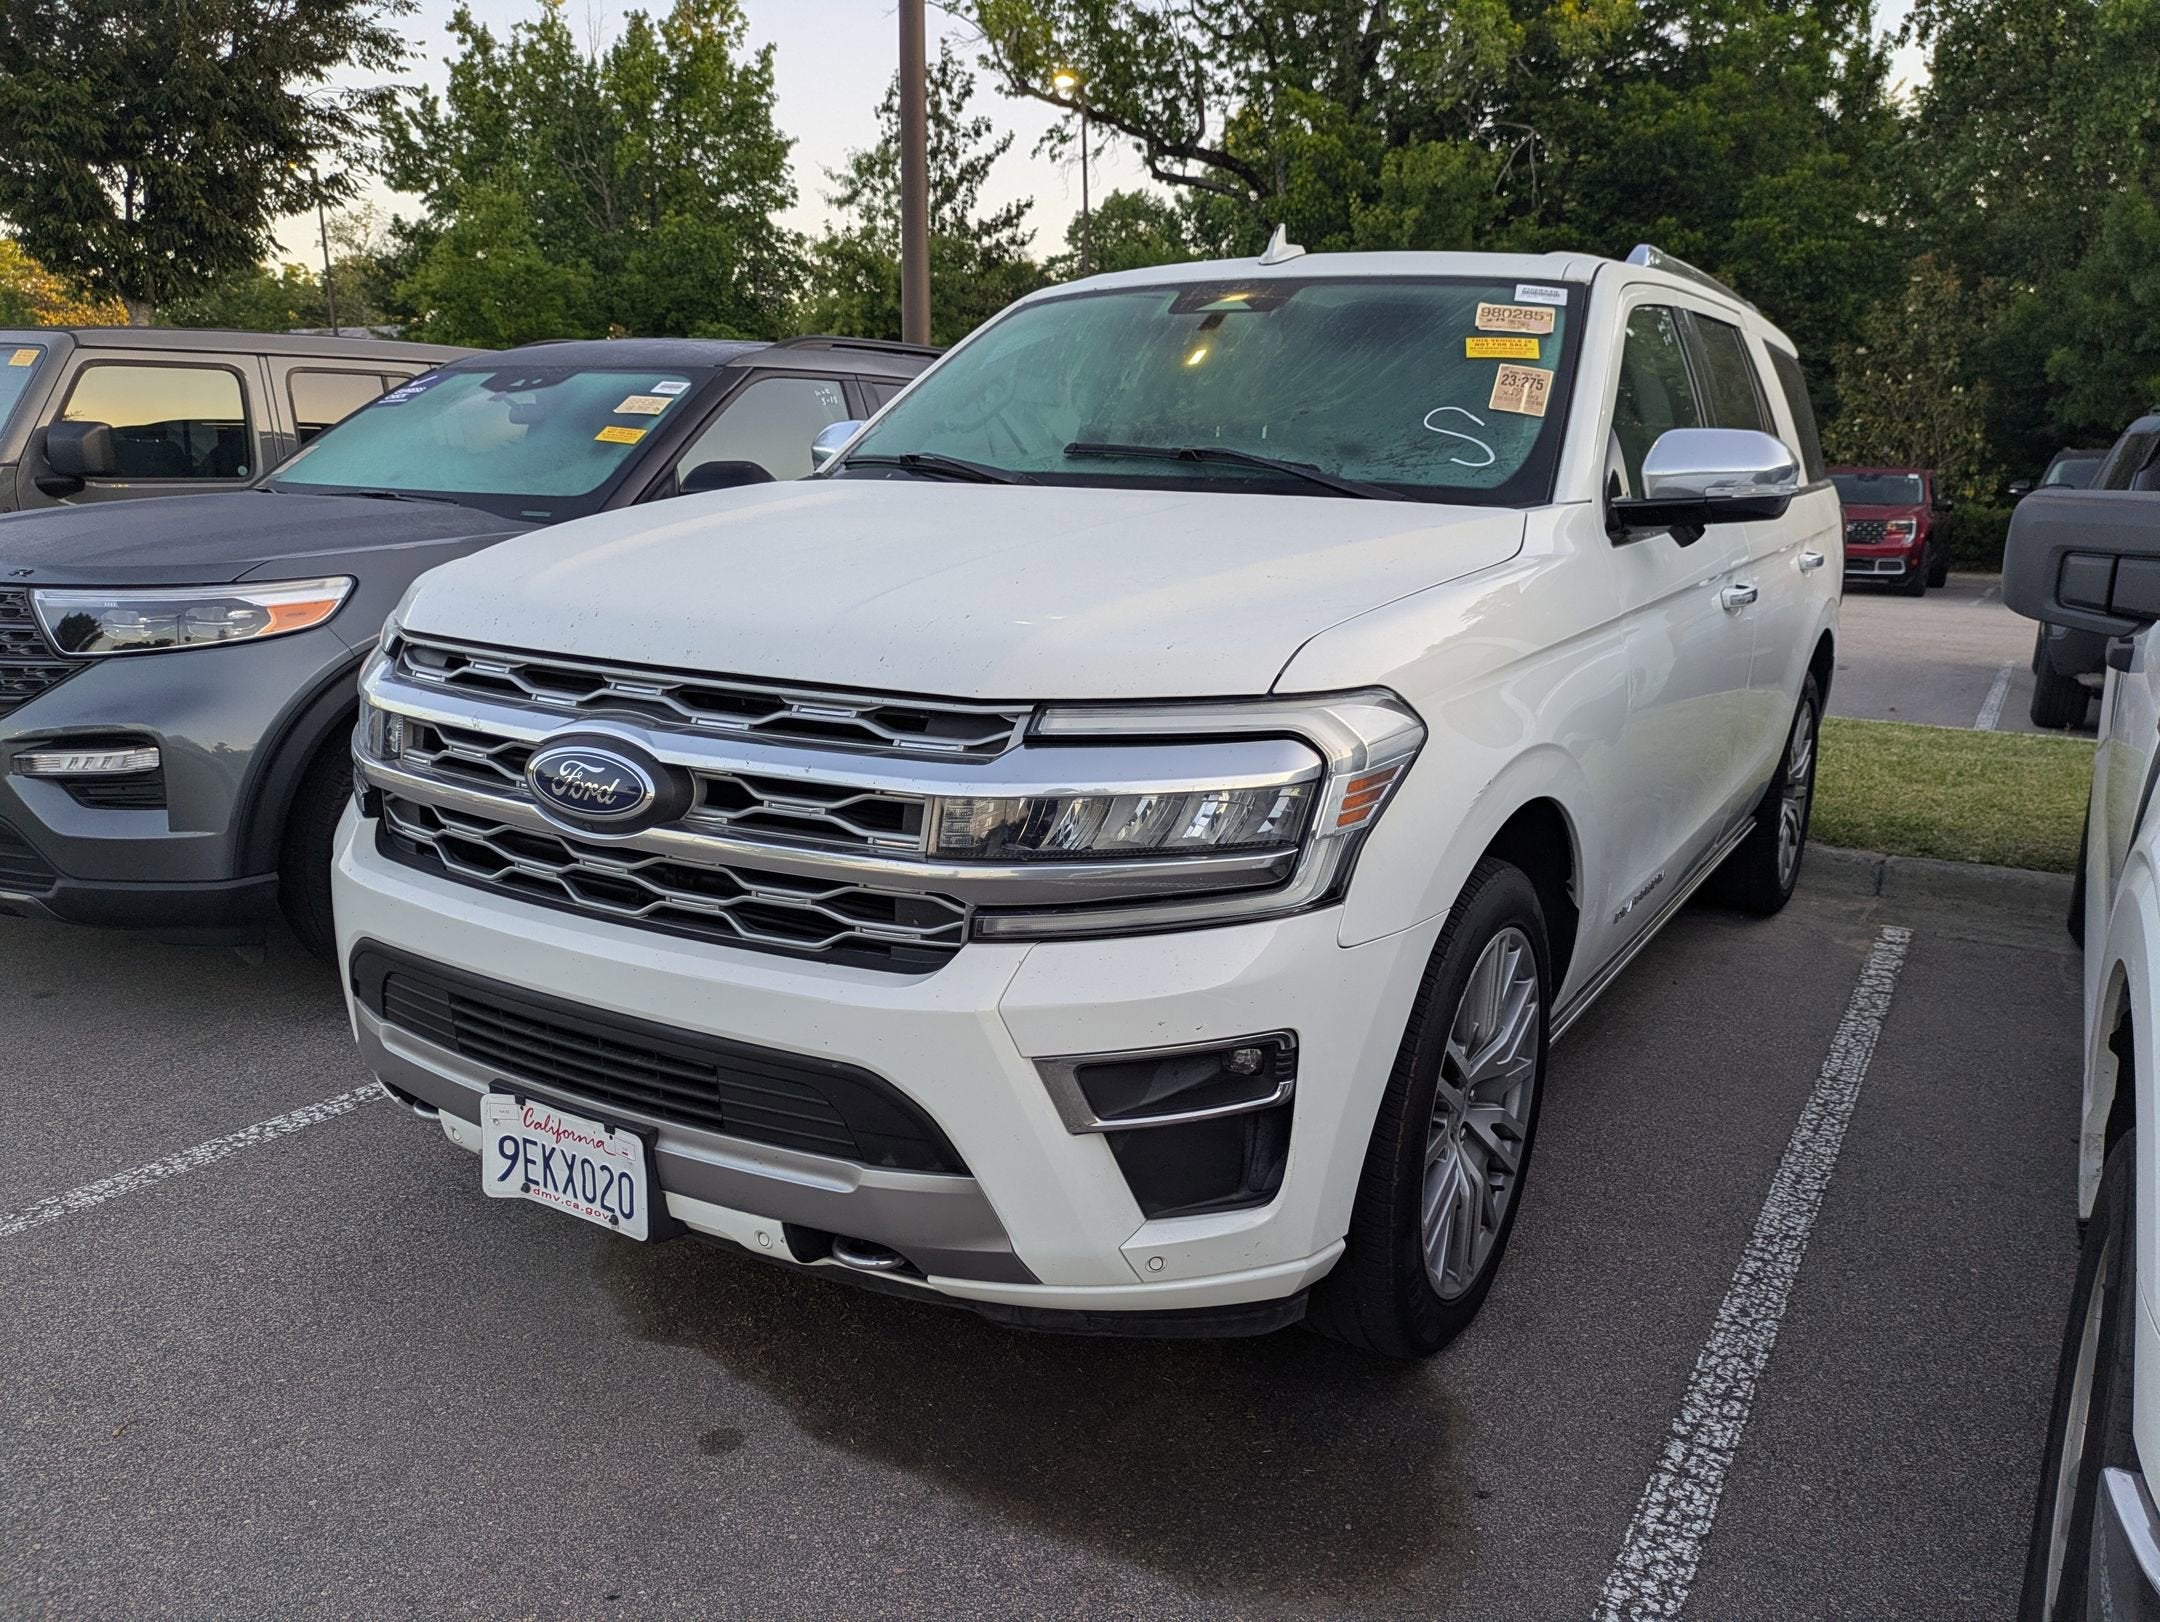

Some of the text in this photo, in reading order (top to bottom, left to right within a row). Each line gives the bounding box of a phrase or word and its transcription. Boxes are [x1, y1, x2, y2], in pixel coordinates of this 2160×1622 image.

[1424, 406, 1496, 467] S
[551, 760, 621, 805] Ford
[523, 1107, 616, 1156] California
[497, 1134, 634, 1220] 9EKX020
[532, 1188, 610, 1221] dmv.ca.gov
